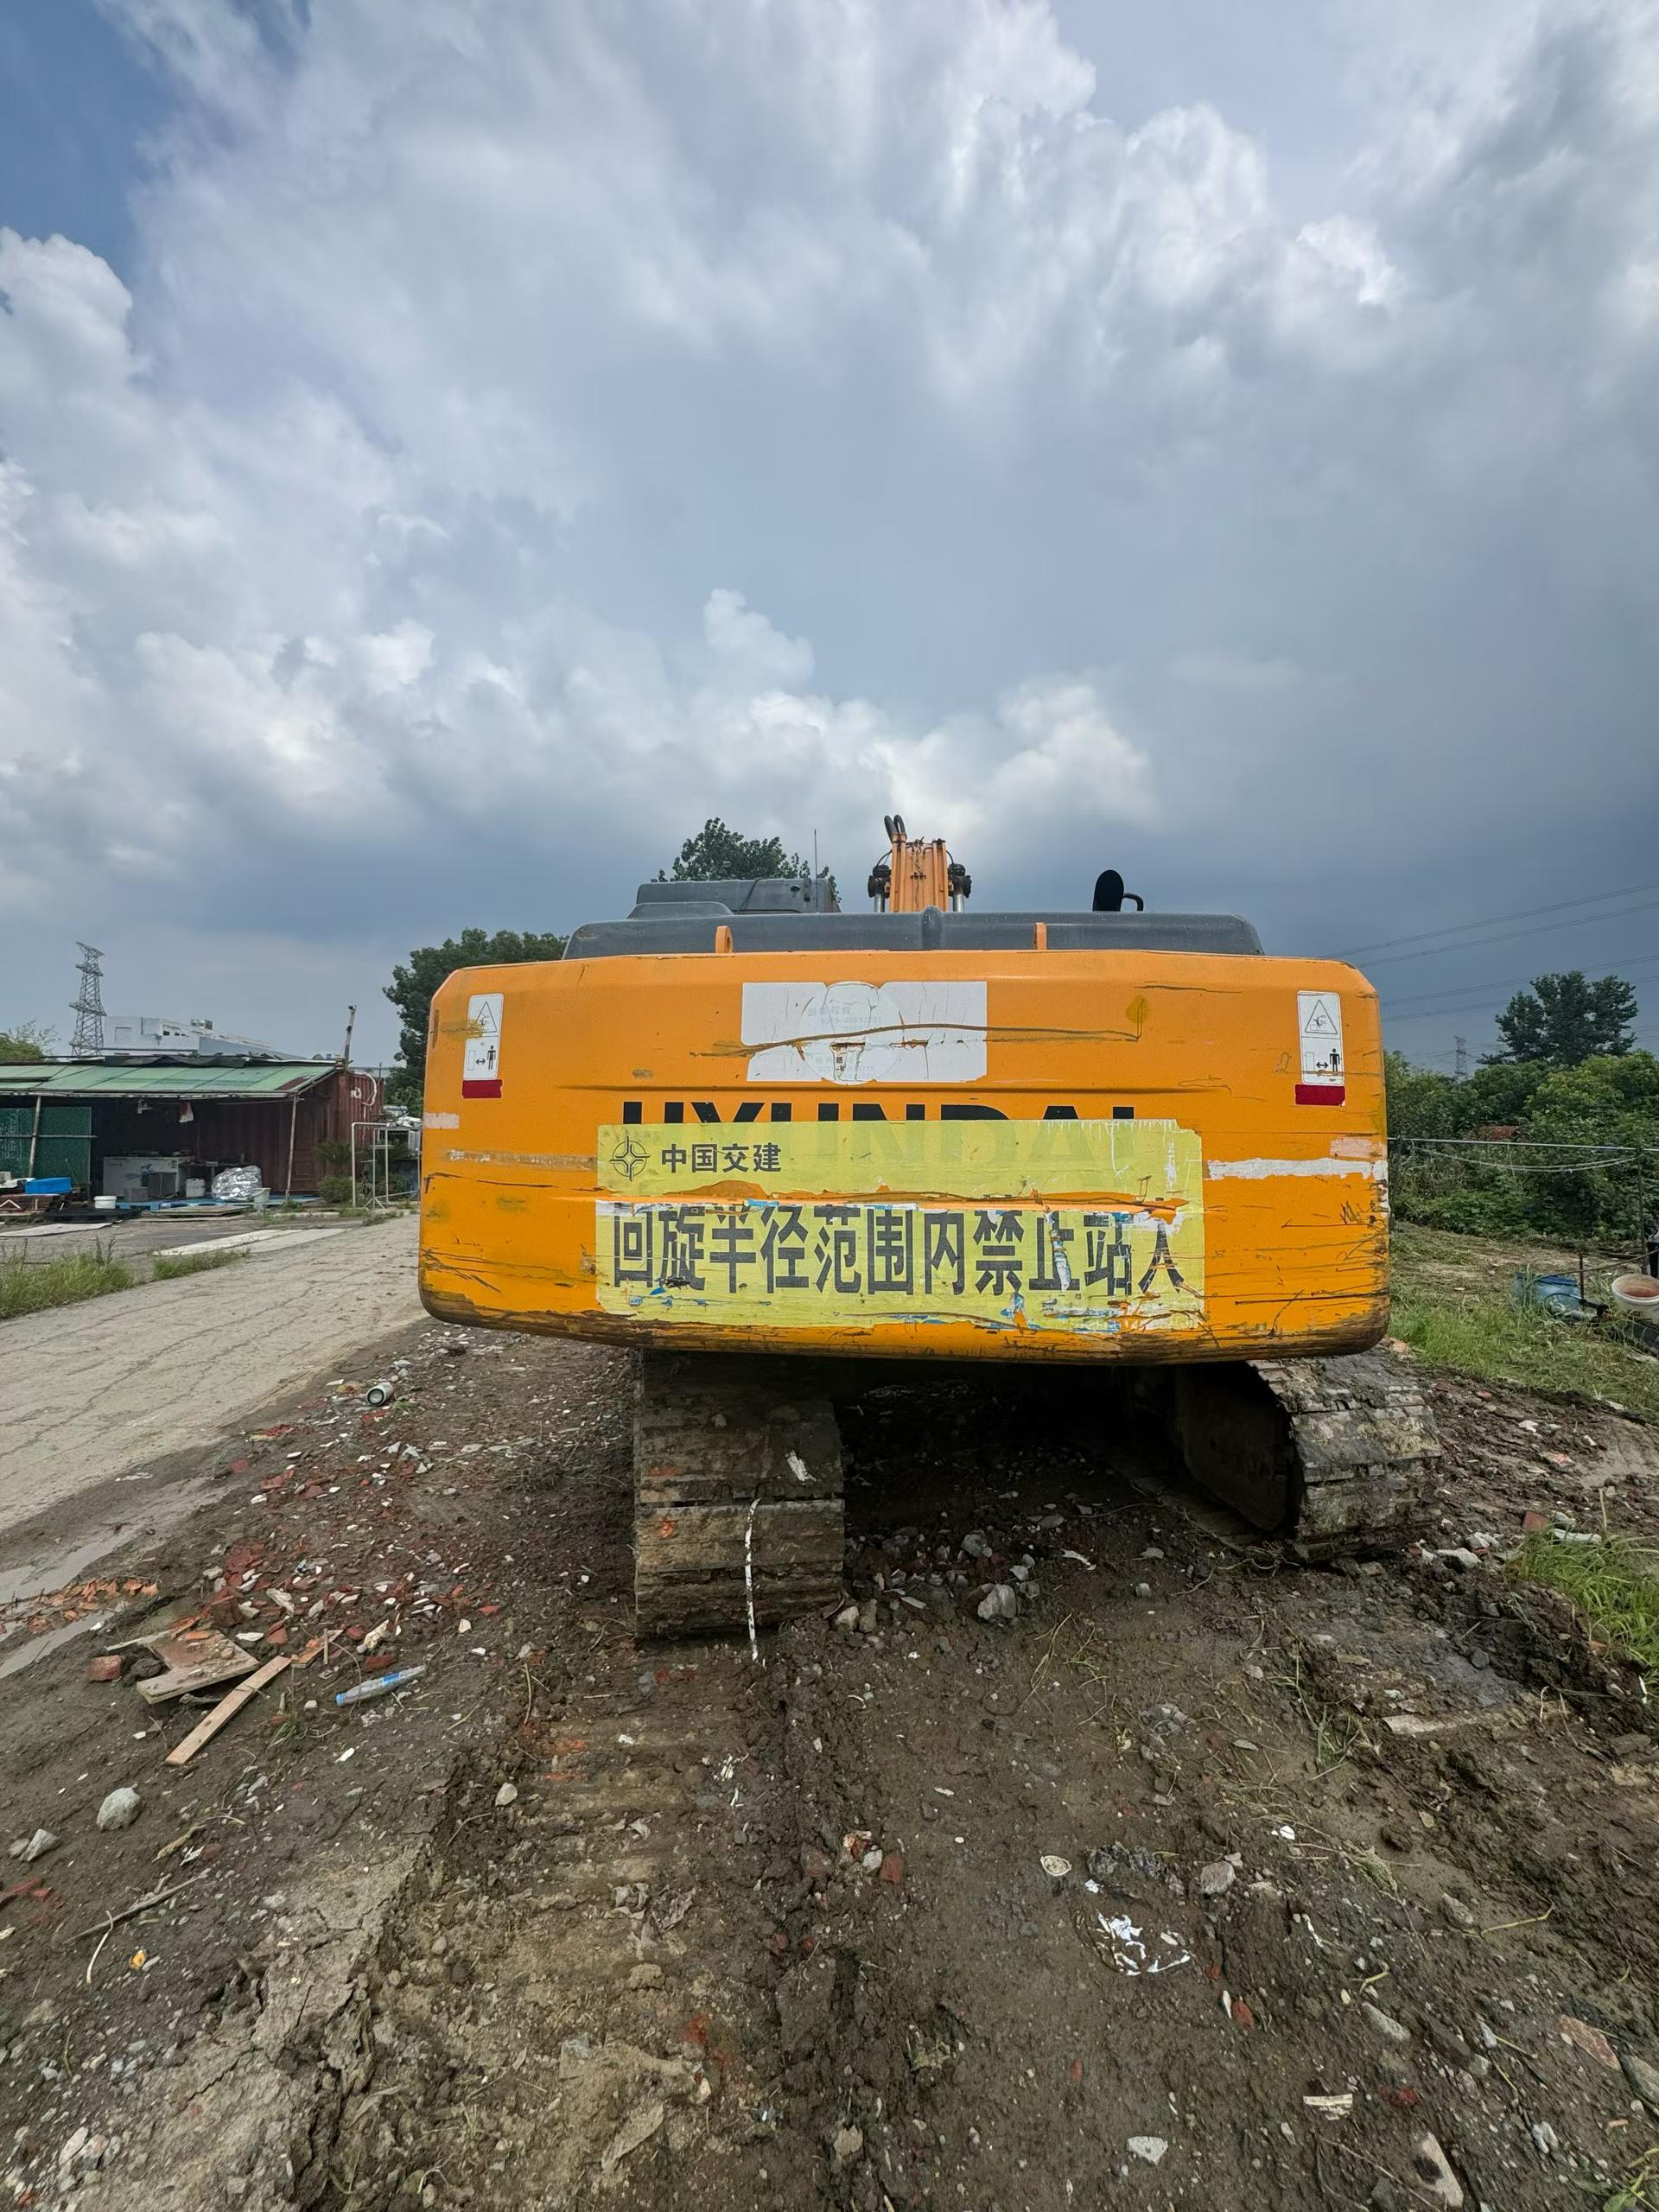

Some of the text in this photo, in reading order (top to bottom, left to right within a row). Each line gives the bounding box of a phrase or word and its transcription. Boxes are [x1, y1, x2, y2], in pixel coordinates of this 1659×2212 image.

[661, 1142, 782, 1173] 中国交建
[614, 1205, 1185, 1295] 回旋半径范围内禁止站人
